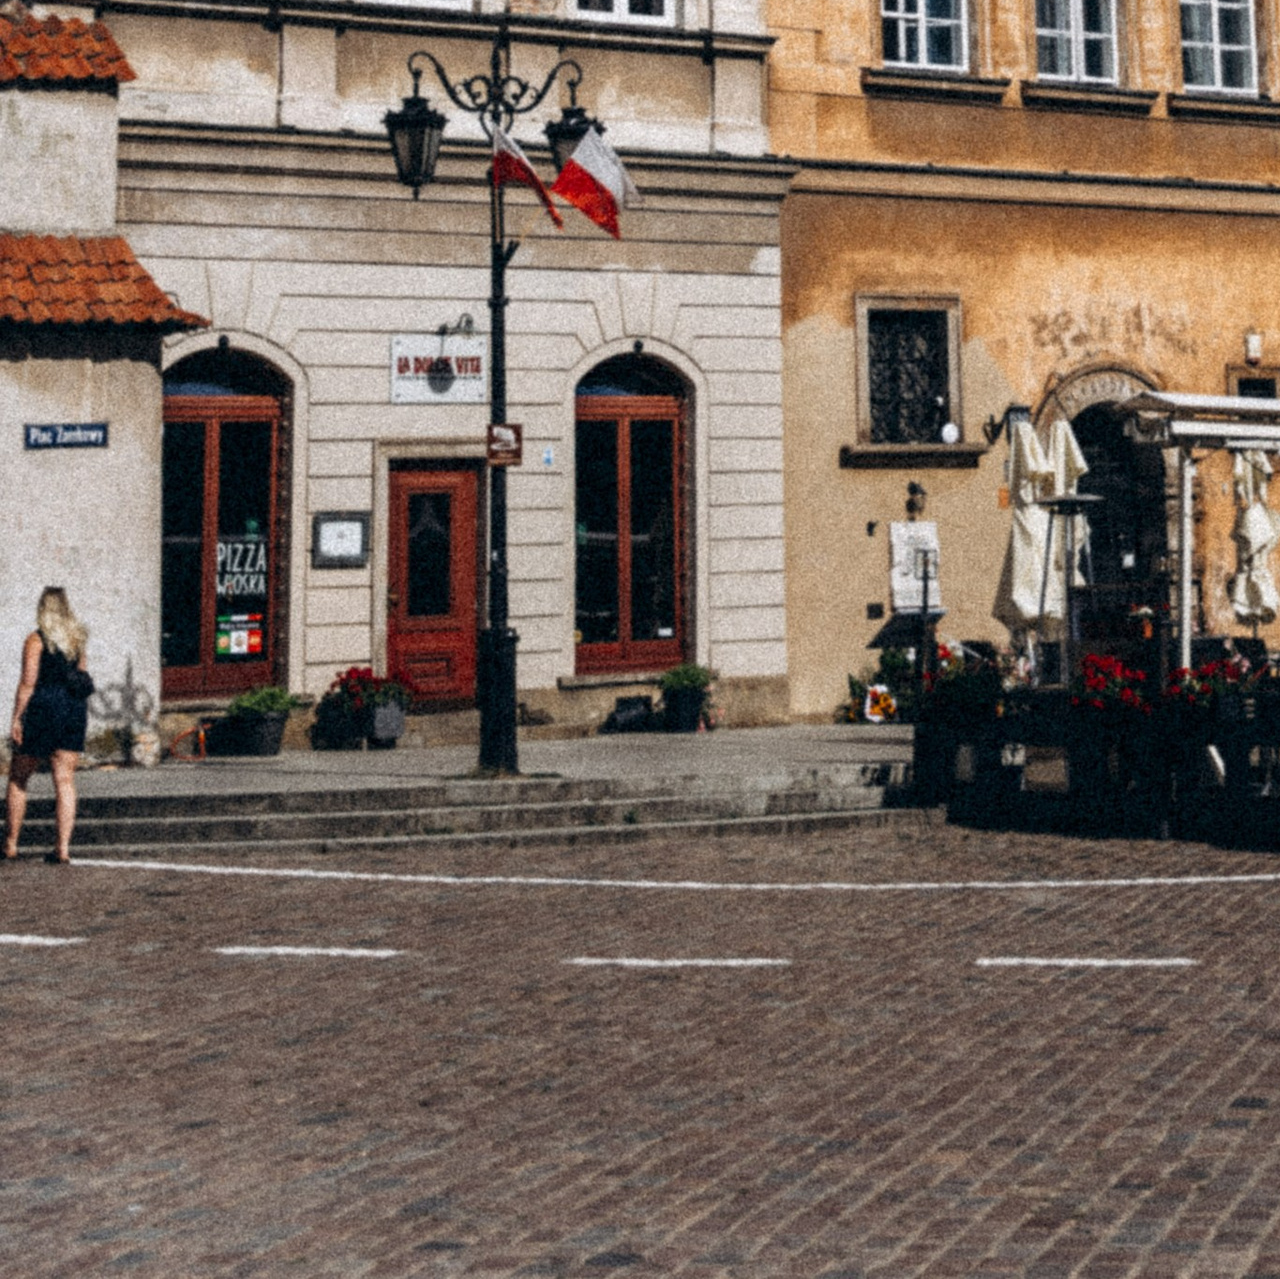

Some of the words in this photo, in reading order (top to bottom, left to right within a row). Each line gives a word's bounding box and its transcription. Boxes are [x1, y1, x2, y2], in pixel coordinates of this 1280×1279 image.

[397, 356, 411, 374] LA
[29, 426, 53, 444] Plac
[56, 425, 104, 444] Zamkowy
[216, 542, 267, 572] PIZZA
